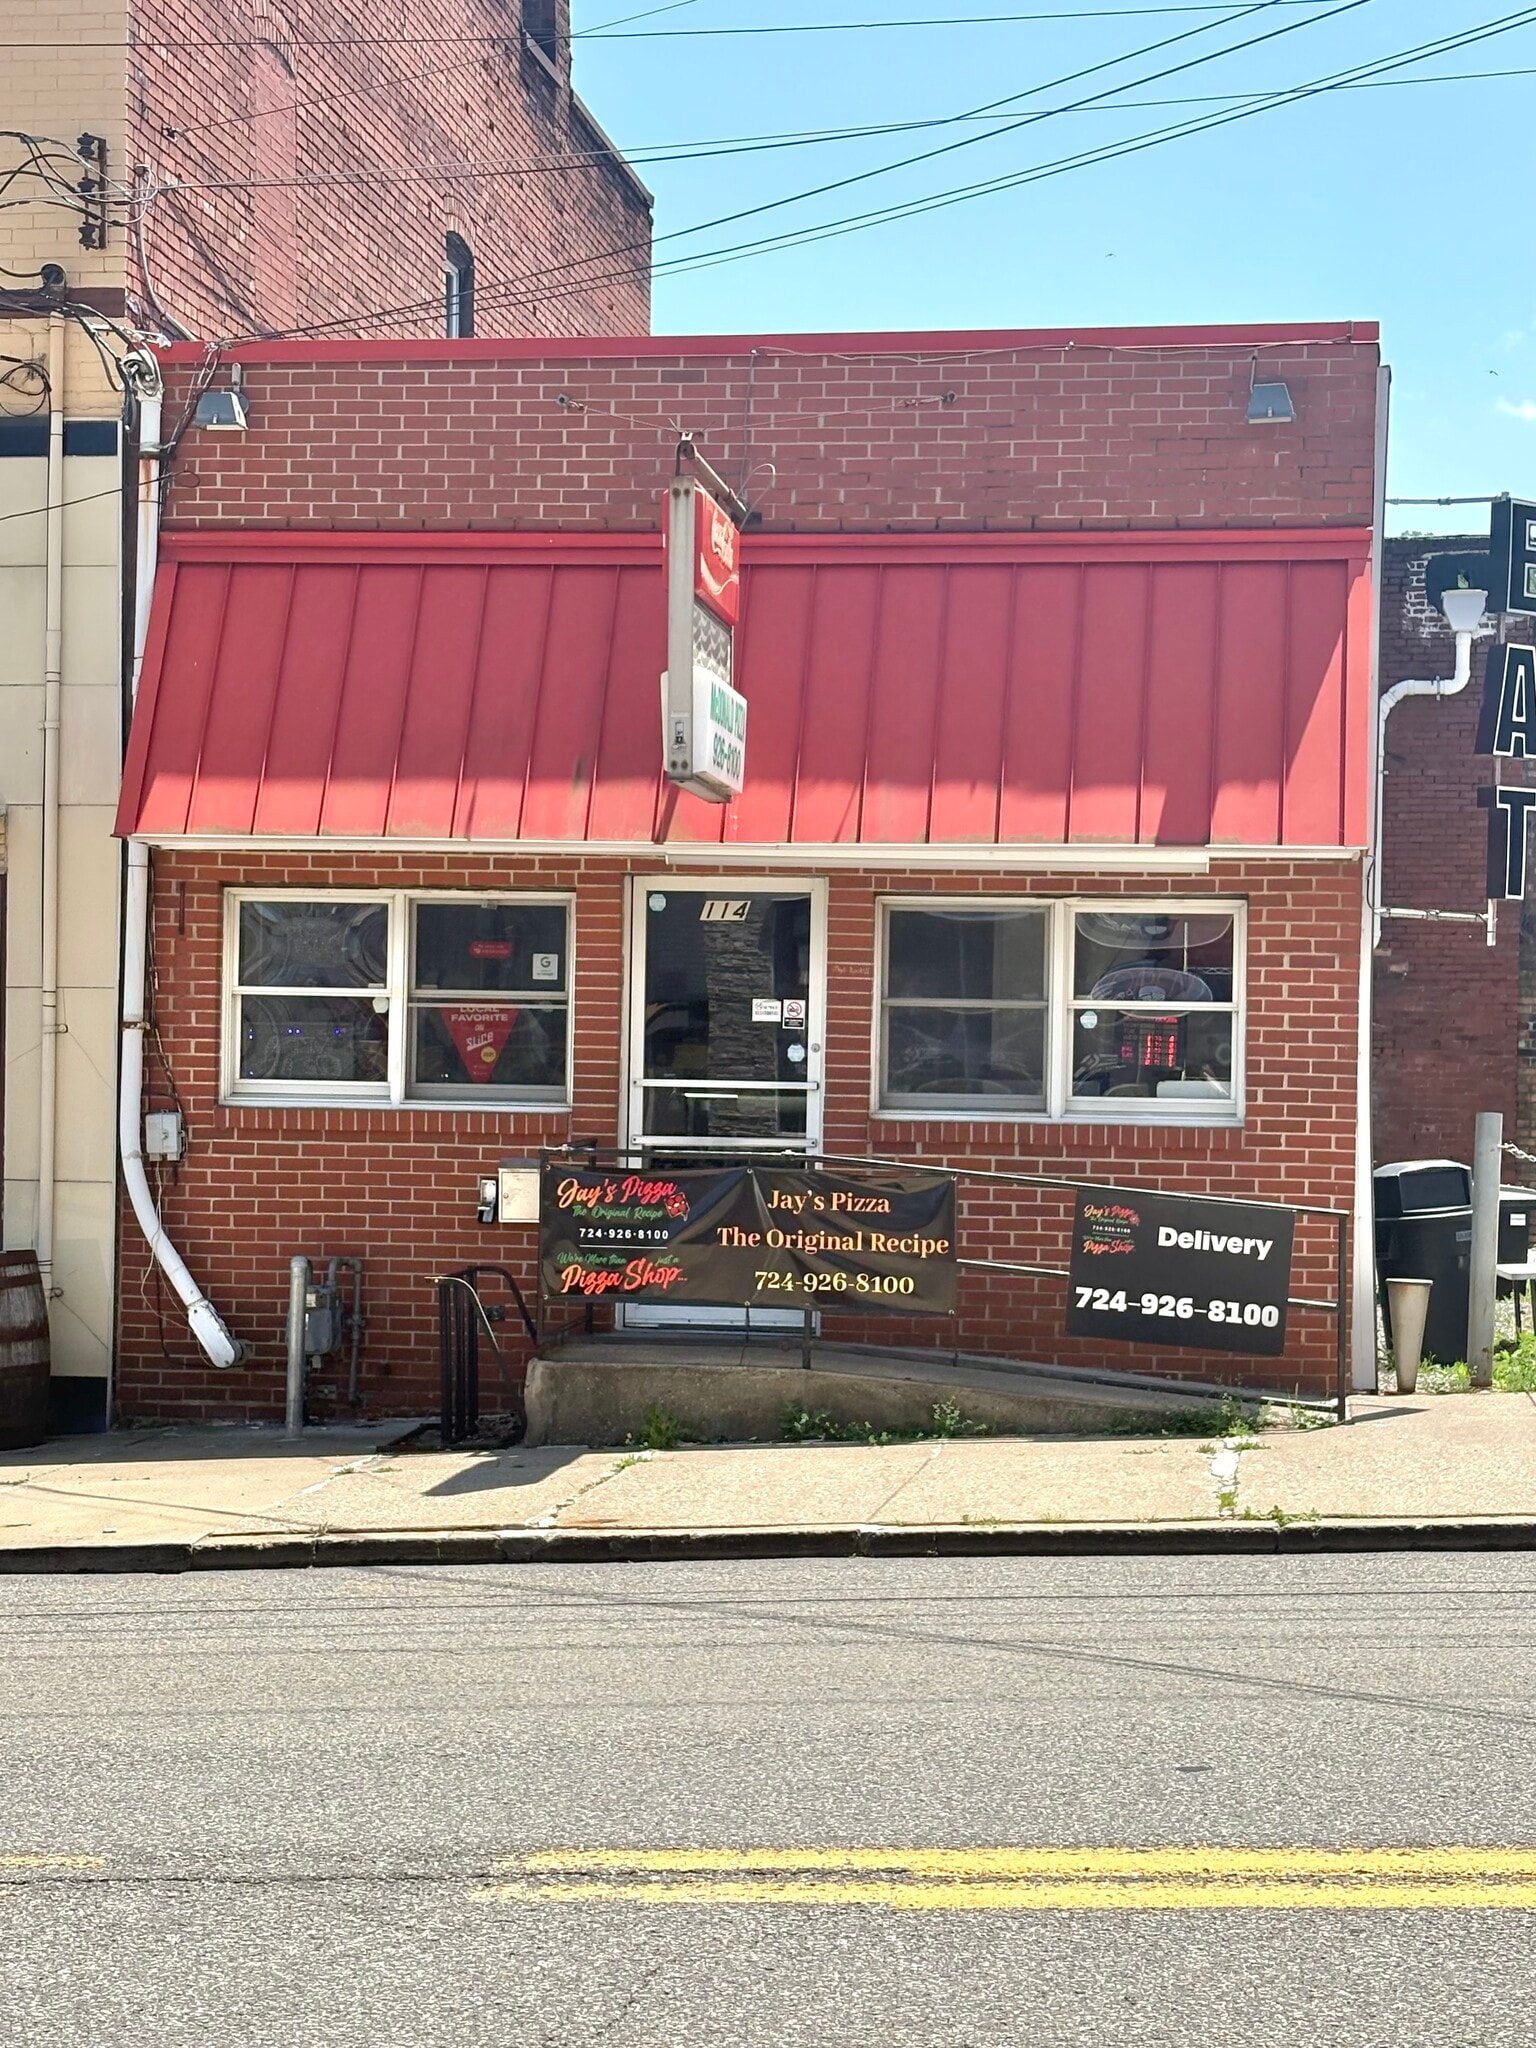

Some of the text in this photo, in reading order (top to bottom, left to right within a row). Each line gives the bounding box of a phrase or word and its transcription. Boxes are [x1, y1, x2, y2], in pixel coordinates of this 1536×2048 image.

[706, 902, 748, 919] 114
[451, 1013, 508, 1022] FAVORITE
[557, 1176, 677, 1208] Jay's Pizza
[767, 1190, 891, 1215] Jay’s Pizza
[572, 1205, 663, 1220] The Original Recipe
[717, 1227, 949, 1258] The Original Recipe
[1157, 1226, 1273, 1261] Delivery
[561, 1264, 622, 1294] Pizza
[755, 1271, 914, 1294] 724-926-8100
[1075, 1286, 1280, 1328] 724-926-8100
